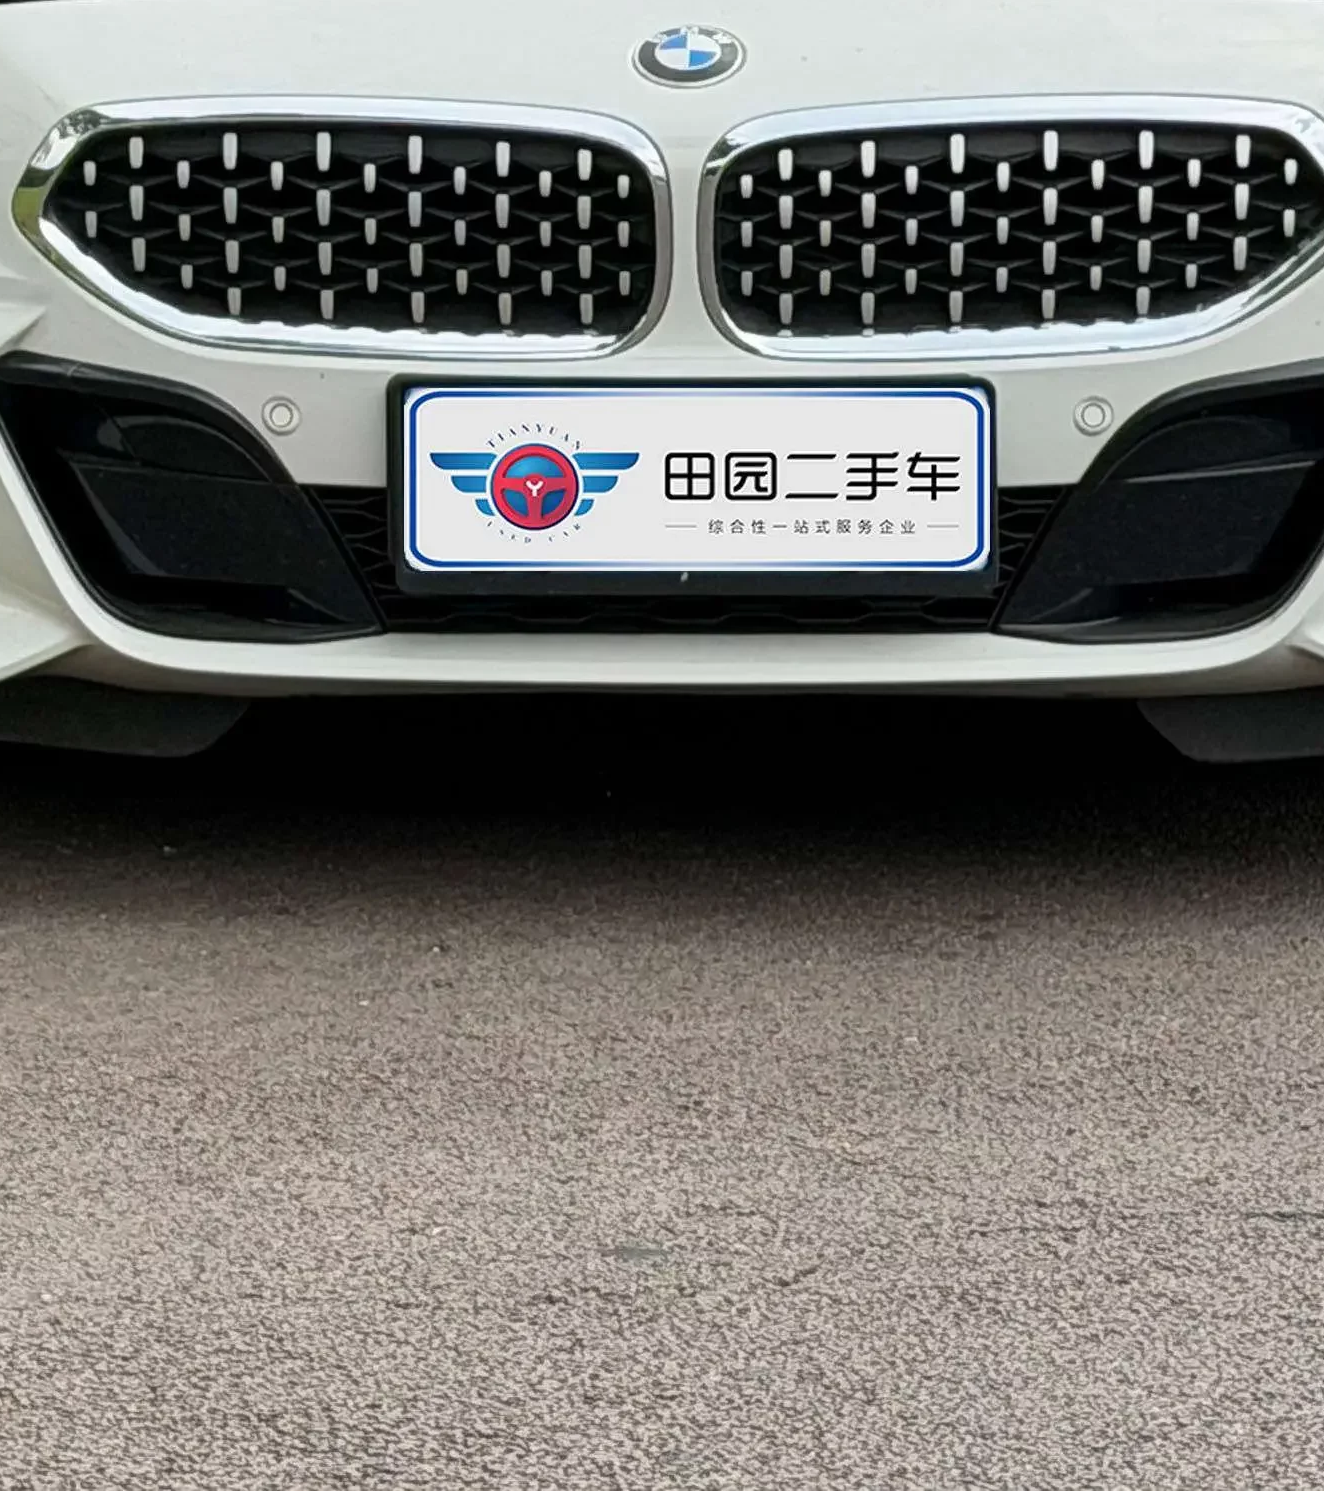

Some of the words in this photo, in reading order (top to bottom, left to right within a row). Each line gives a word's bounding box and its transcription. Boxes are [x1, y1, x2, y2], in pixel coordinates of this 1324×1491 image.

[664, 451, 961, 501] 田园二手车
[708, 518, 916, 535] 综合性一站式服务企业
